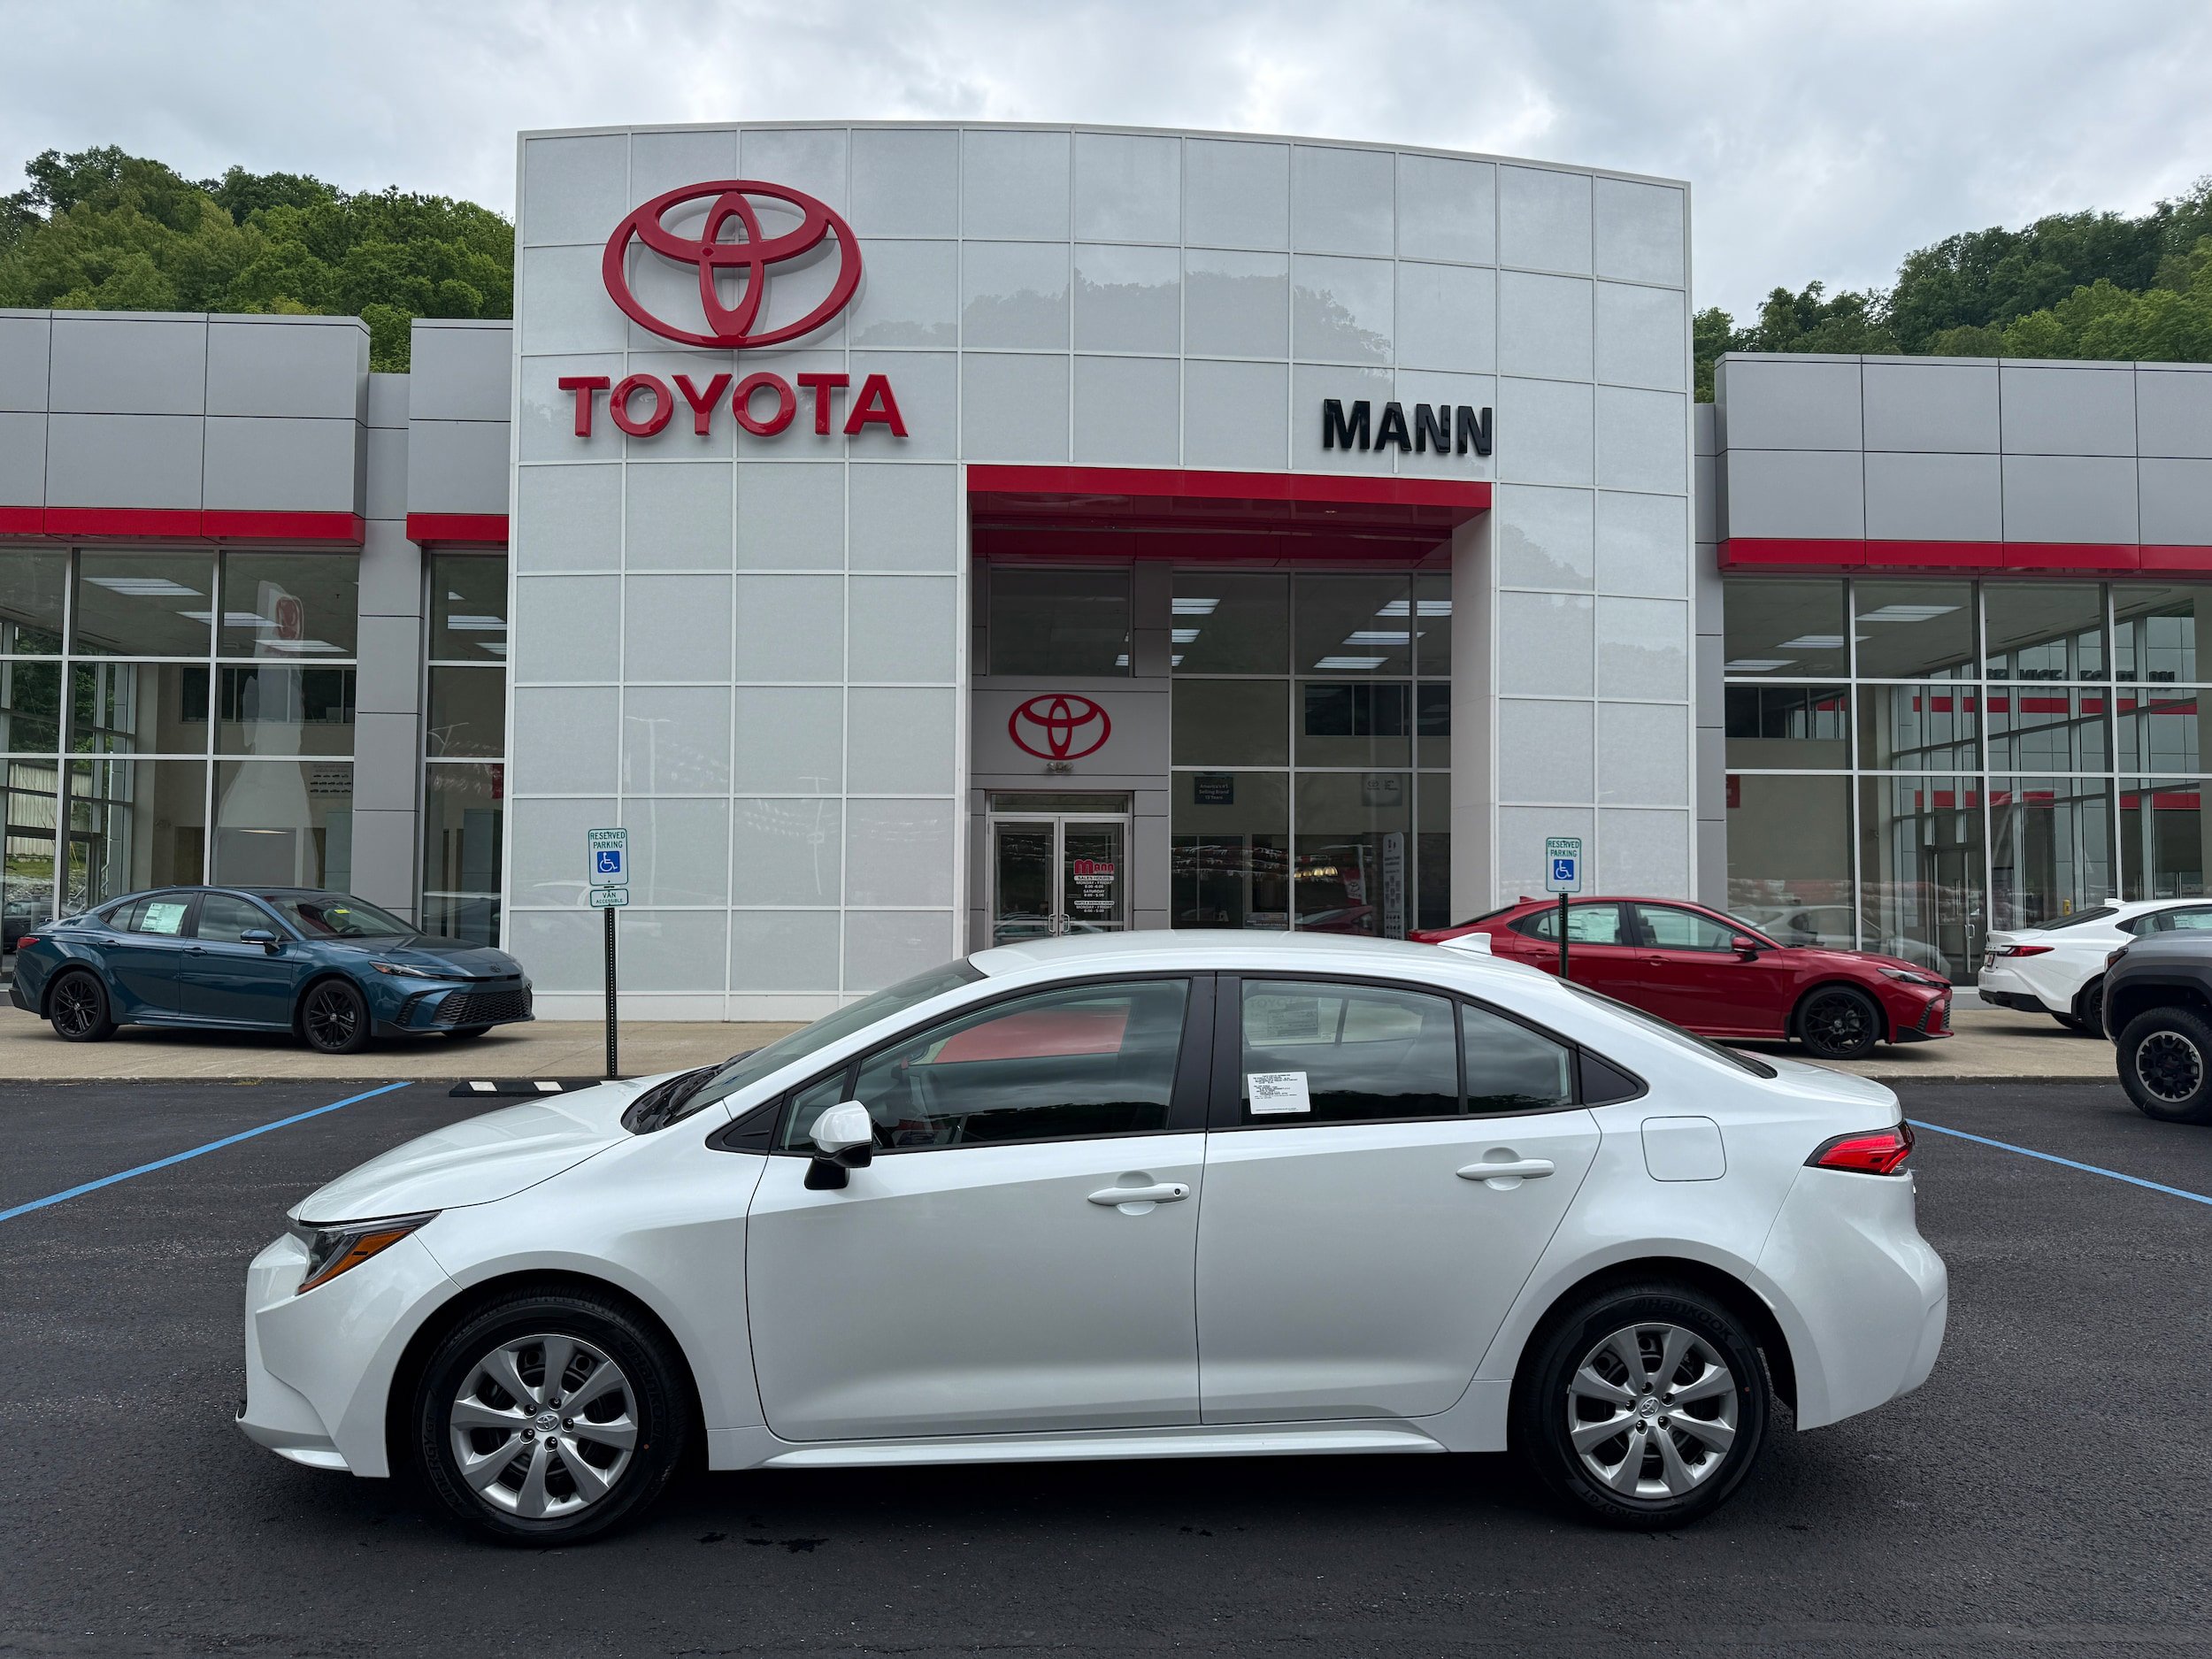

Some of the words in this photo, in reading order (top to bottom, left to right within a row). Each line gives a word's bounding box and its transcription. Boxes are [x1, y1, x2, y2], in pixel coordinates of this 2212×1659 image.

[558, 372, 909, 438] TOYOTA
[1324, 398, 1493, 455] MANN
[590, 832, 626, 840] RESERVED
